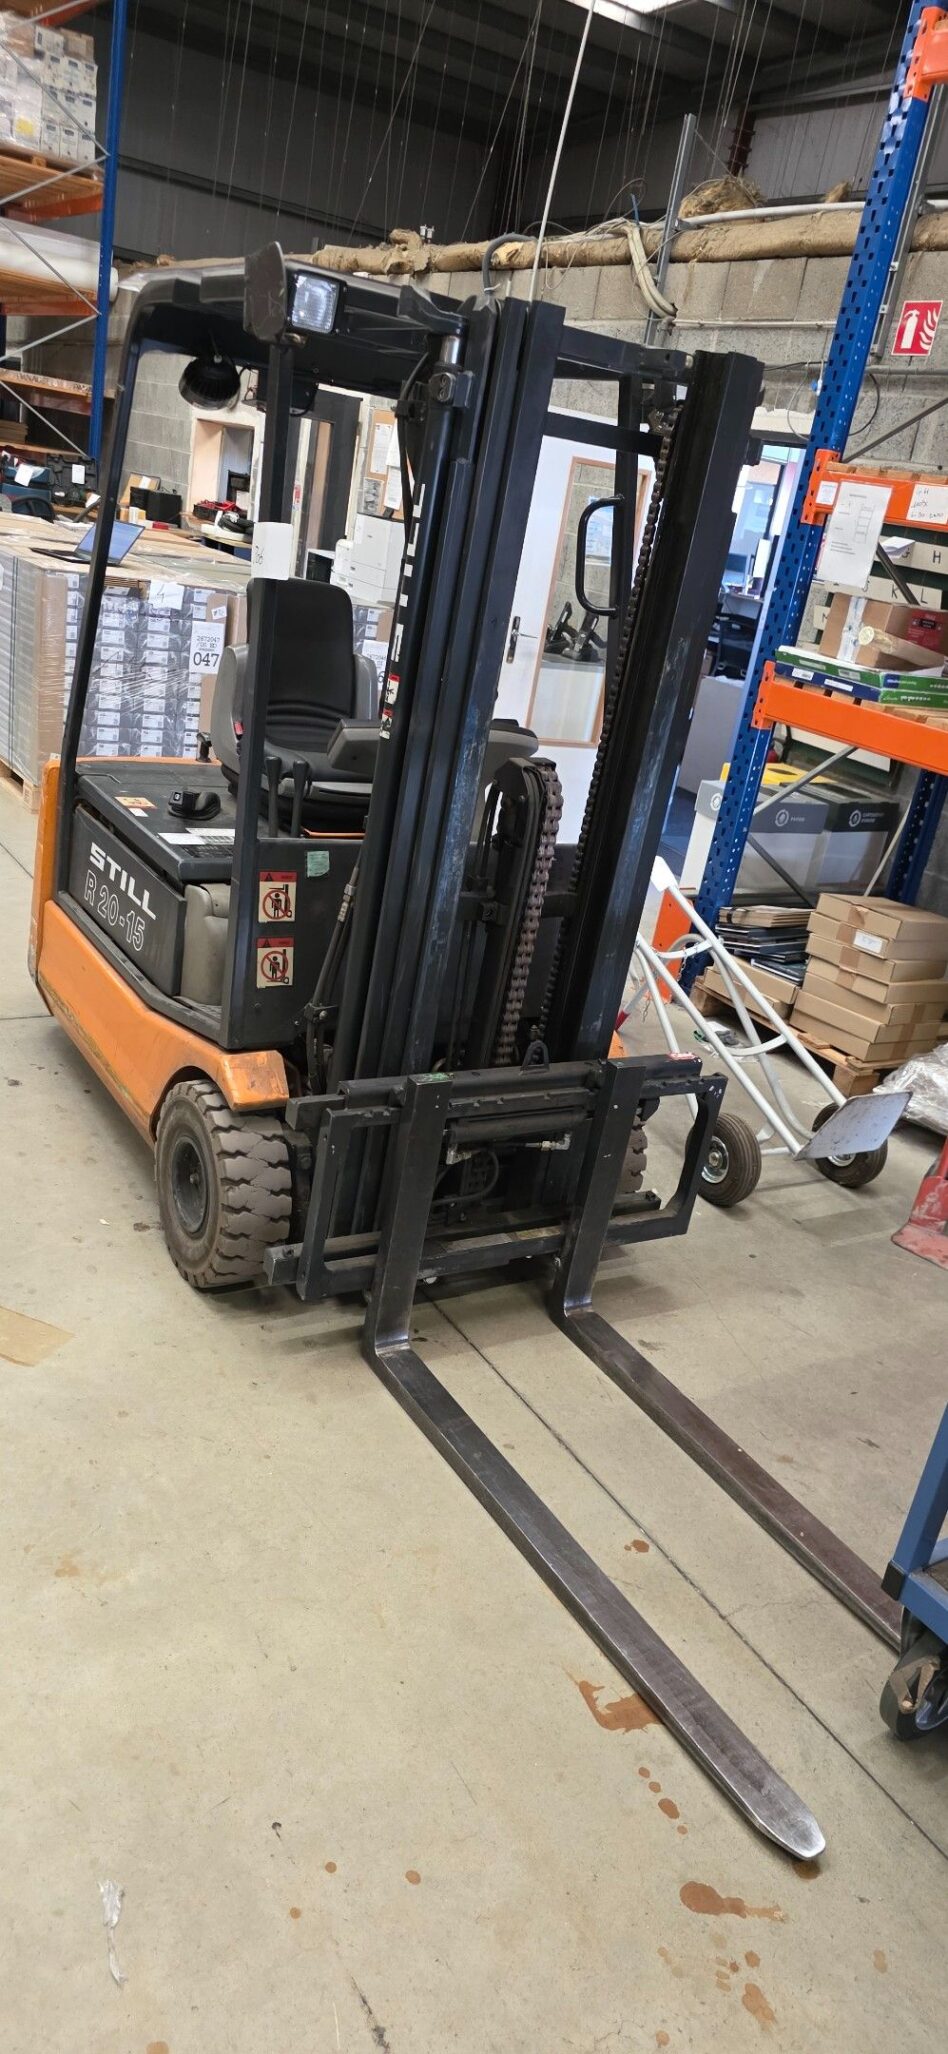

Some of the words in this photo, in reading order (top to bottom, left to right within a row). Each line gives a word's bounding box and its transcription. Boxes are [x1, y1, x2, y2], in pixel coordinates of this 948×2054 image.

[932, 549, 942, 564] H
[891, 583, 900, 599] K
[920, 587, 929, 604] L
[193, 651, 220, 668] 047
[89, 842, 157, 921] STILL
[84, 869, 97, 906] R
[97, 885, 146, 952] 20-15
